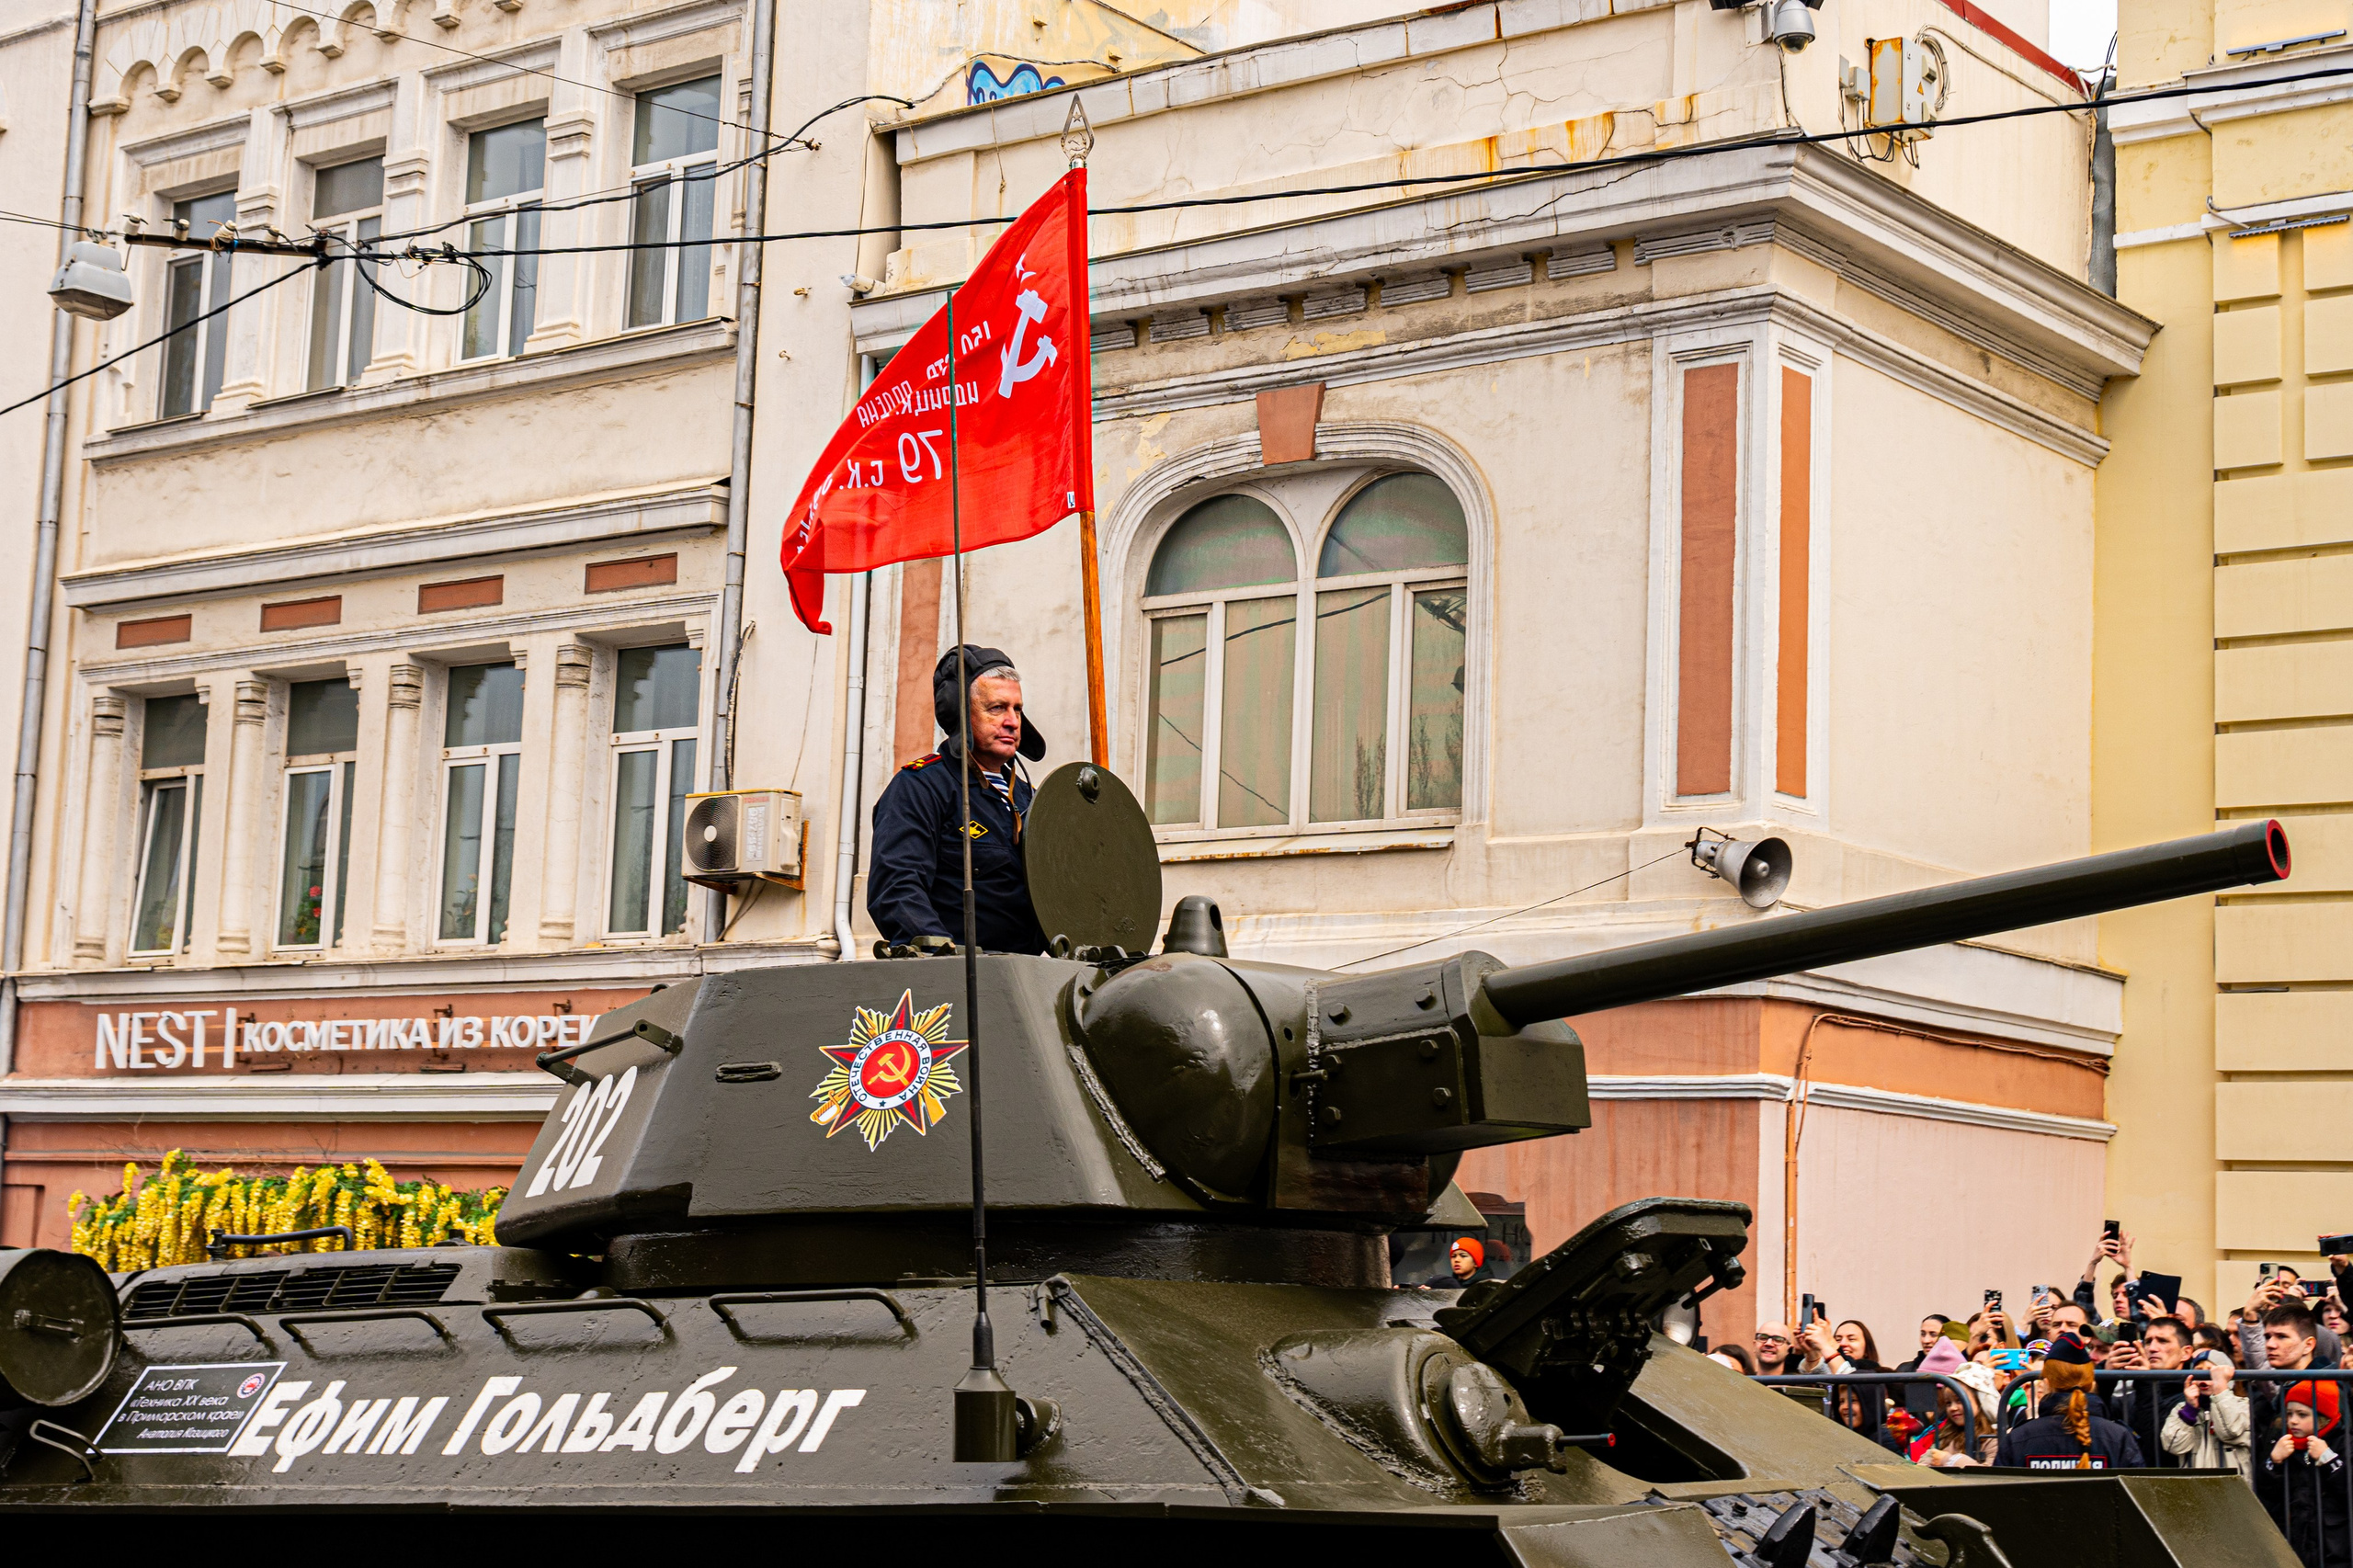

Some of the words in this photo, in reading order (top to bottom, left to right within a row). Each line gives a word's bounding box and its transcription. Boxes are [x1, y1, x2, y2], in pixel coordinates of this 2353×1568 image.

[95, 1009, 218, 1070] NEST
[243, 1018, 434, 1052] КОСМЕТИКА
[438, 1016, 483, 1049] ИЗ
[851, 1030, 927, 1102] ОТЕЧЕСТВЕННАЯ
[525, 1065, 638, 1198] 202
[143, 1380, 175, 1392] АНО
[173, 1379, 199, 1391] ВПК
[199, 1396, 230, 1407] века
[118, 1413, 127, 1423] в
[126, 1410, 207, 1425] Приморском
[227, 1380, 450, 1473] Ефим
[441, 1366, 867, 1473] Гольдберг
